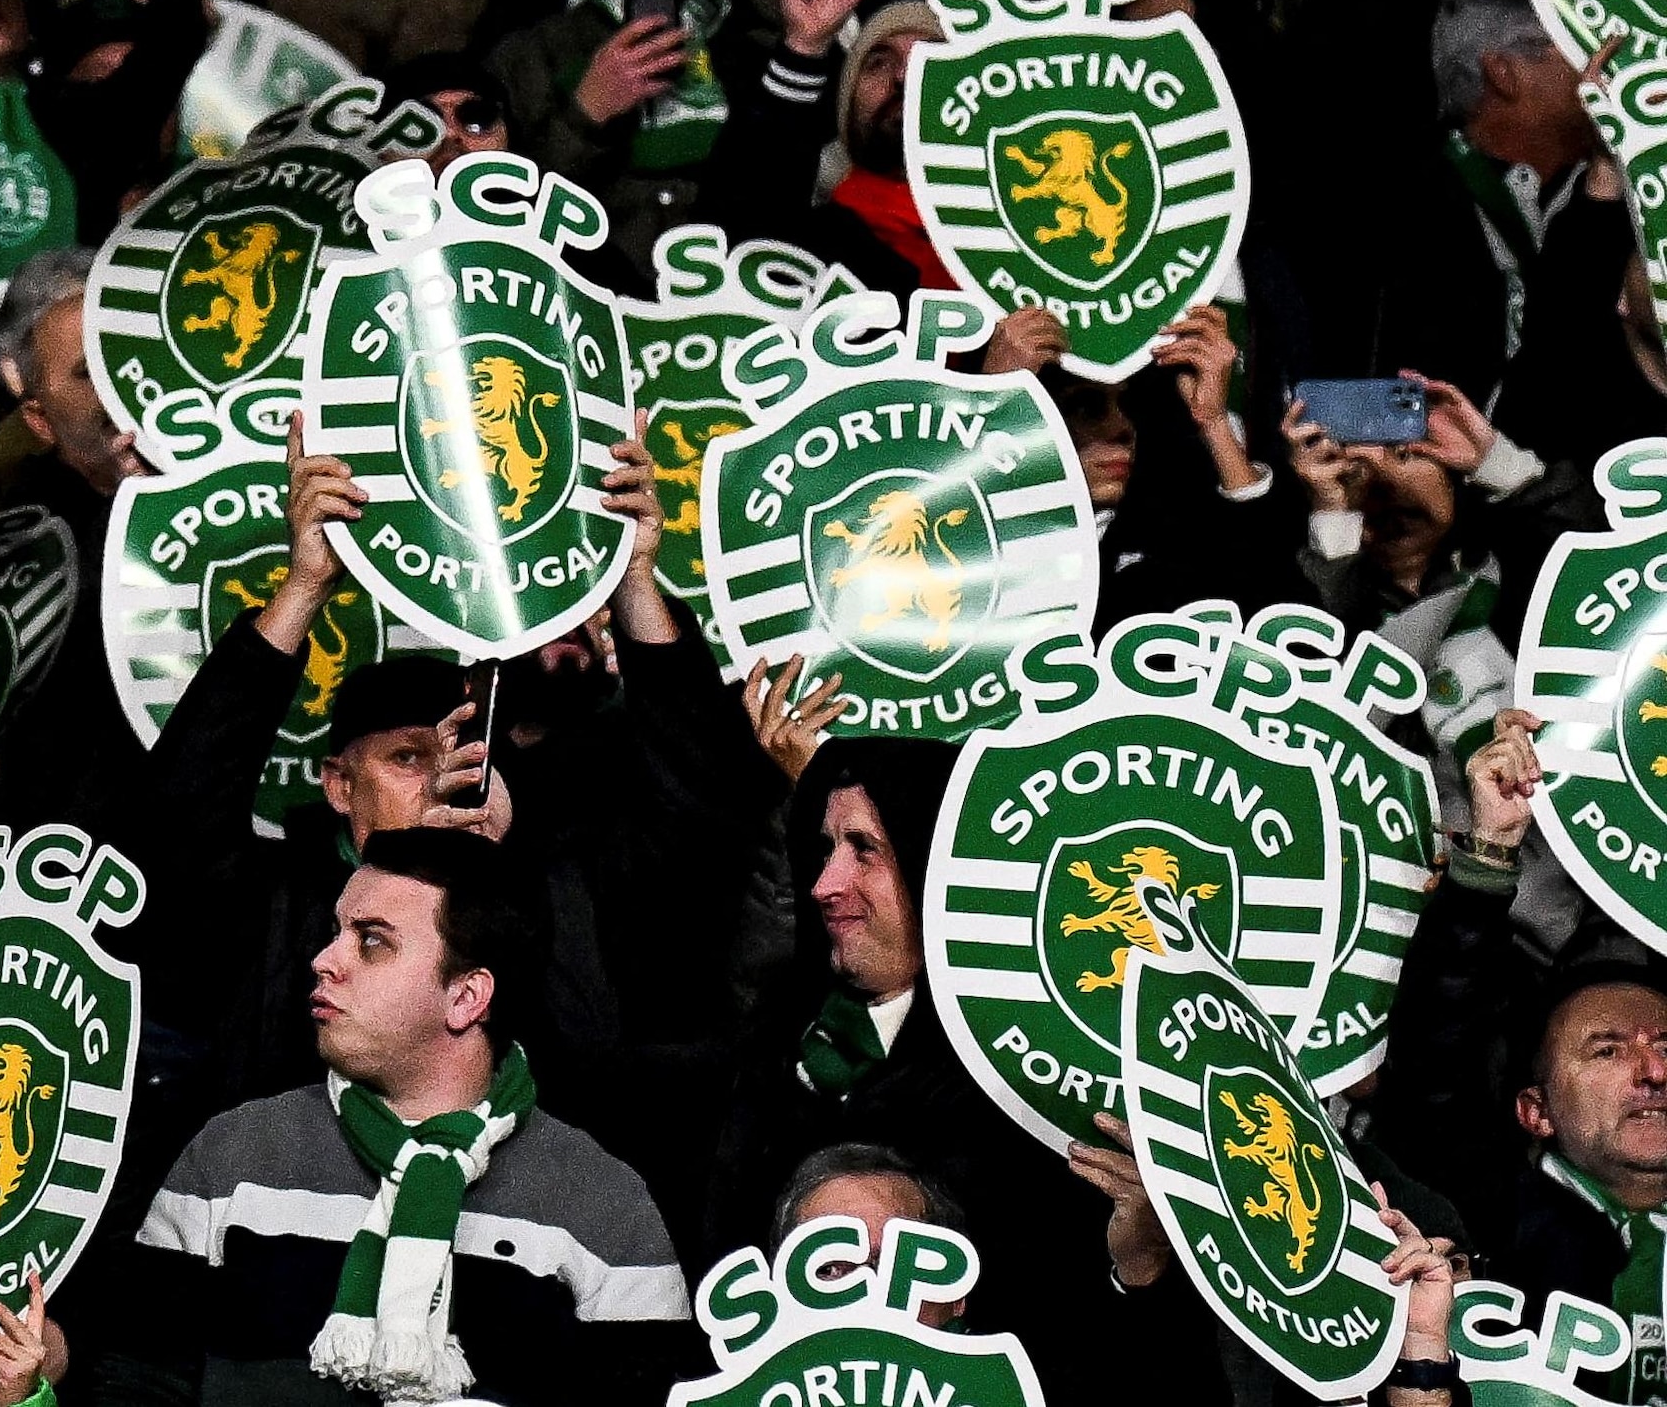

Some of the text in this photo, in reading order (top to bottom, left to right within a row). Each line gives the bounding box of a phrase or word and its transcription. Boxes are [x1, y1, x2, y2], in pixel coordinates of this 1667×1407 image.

[936, 48, 1186, 172] SPORTING
[361, 164, 607, 252] SCP
[349, 266, 619, 381] SPORTING
[726, 295, 988, 413] SCP
[741, 400, 1030, 530] SPORTING
[377, 528, 611, 603] PORTUGAL
[1017, 626, 1299, 717] SCP
[987, 738, 1298, 864] SPORTING
[699, 1219, 969, 1355] SCP
[1196, 1230, 1384, 1348] PORTUGAL
[1449, 1290, 1622, 1374] CP
